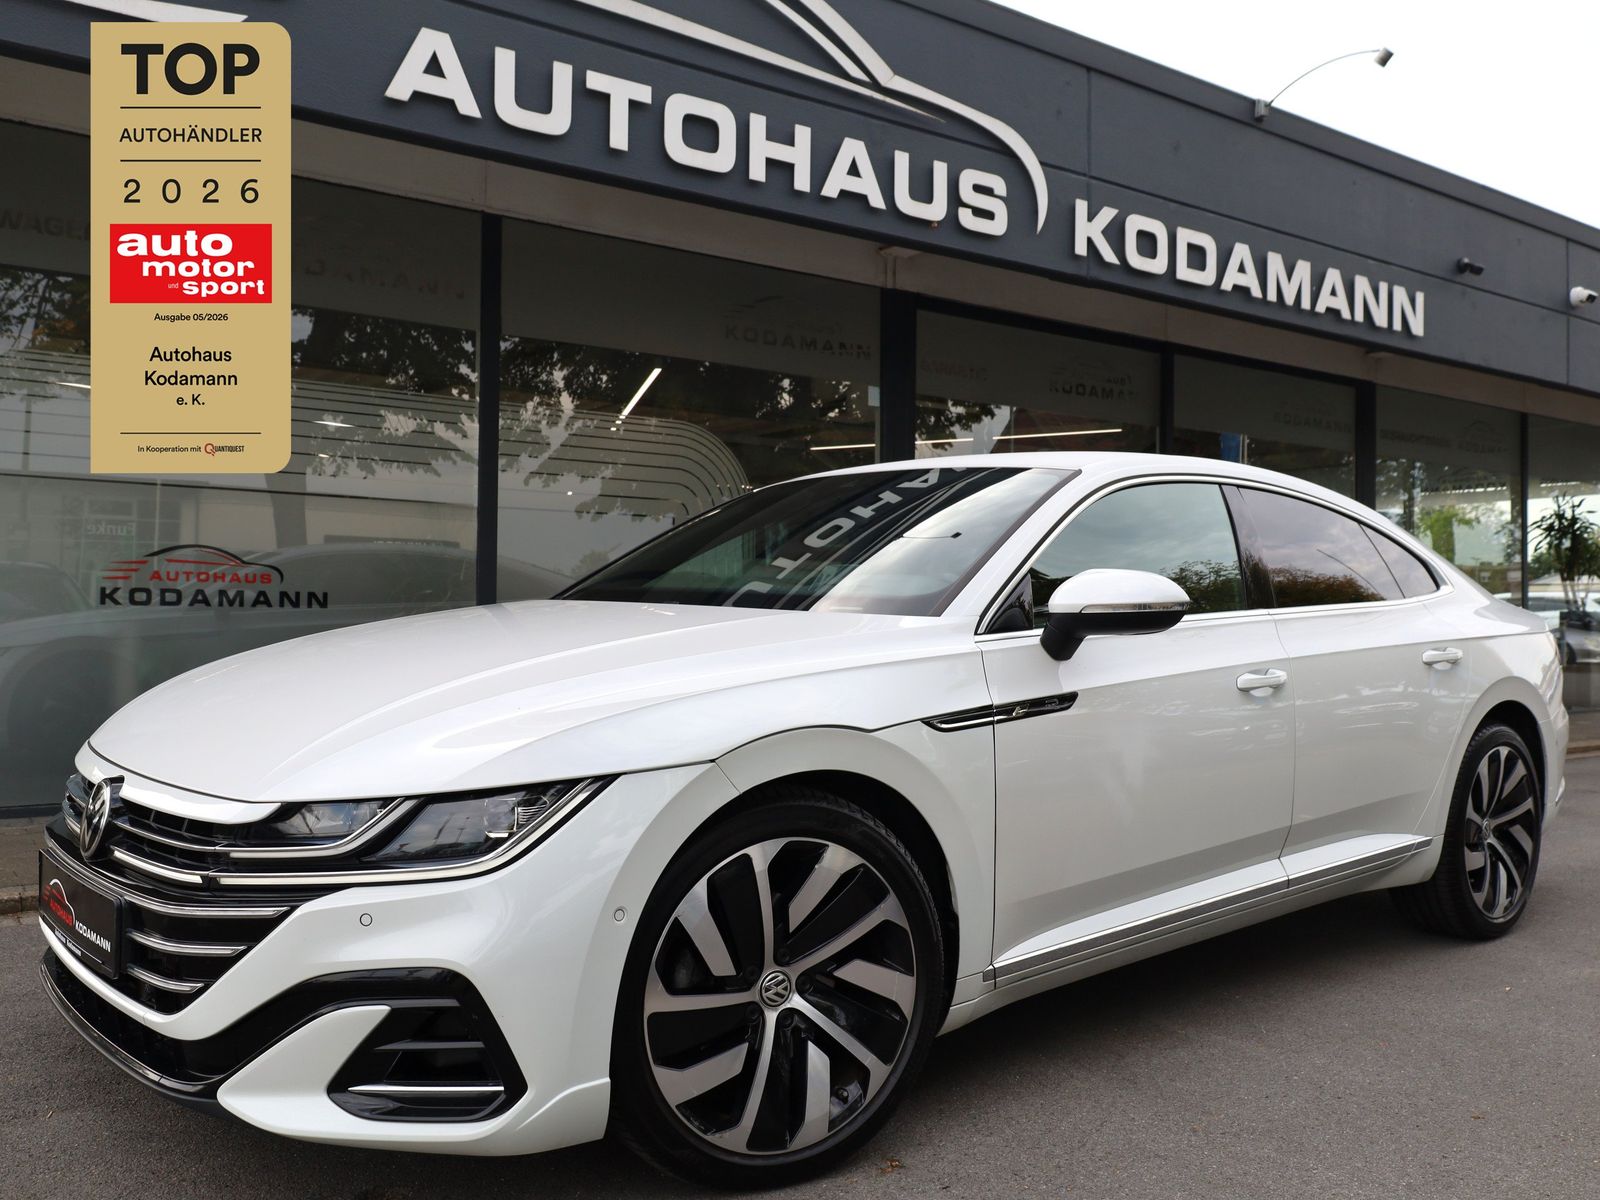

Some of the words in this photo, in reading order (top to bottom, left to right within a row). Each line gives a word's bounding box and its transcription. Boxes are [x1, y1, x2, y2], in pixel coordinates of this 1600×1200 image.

[385, 27, 1009, 236] AUTOHAUS
[1074, 198, 1425, 337] KODAMANN
[149, 571, 272, 584] AUTOHAUS
[99, 586, 328, 609] KODAMANN
[75, 920, 111, 953] KODAMANN
